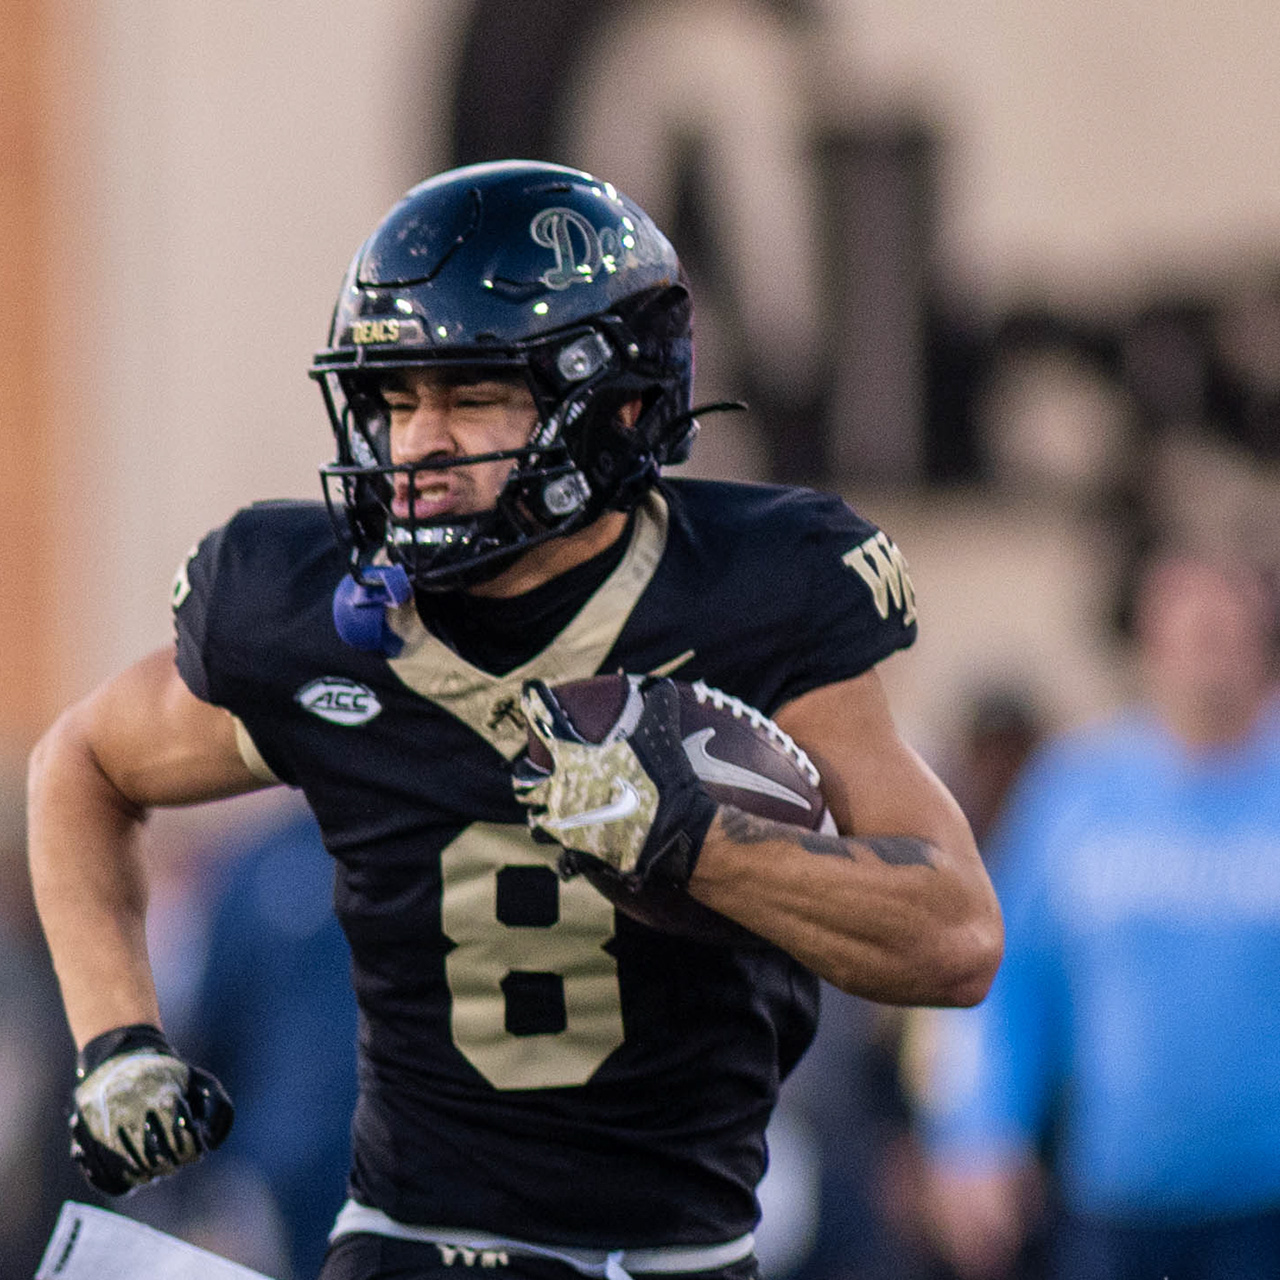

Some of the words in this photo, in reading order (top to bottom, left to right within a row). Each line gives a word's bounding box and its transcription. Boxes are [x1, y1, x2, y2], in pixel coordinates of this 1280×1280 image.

[841, 531, 917, 627] WF
[308, 691, 369, 713] ACC
[440, 821, 625, 1091] 8
